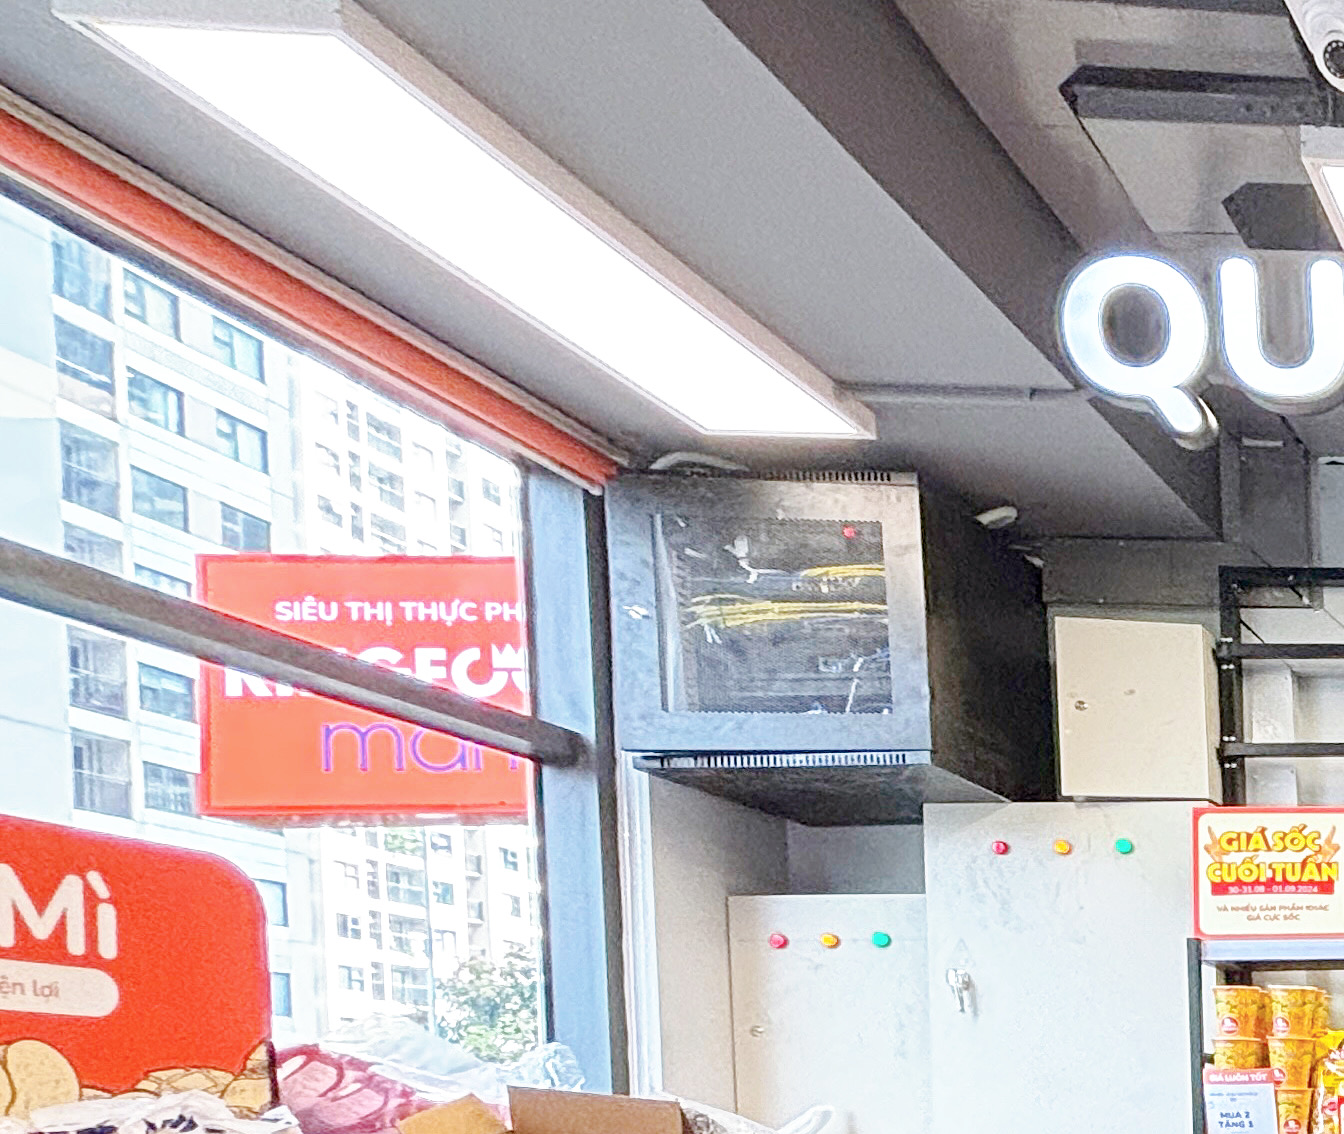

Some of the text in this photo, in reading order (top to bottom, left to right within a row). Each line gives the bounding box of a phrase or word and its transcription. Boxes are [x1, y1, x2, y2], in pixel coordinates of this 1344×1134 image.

[274, 596, 477, 626] SIÊU THỊ THỰC
[1219, 823, 1321, 852] GIÁ SỐC
[1206, 854, 1267, 883] CUỐI
[0, 862, 118, 960] Mì
